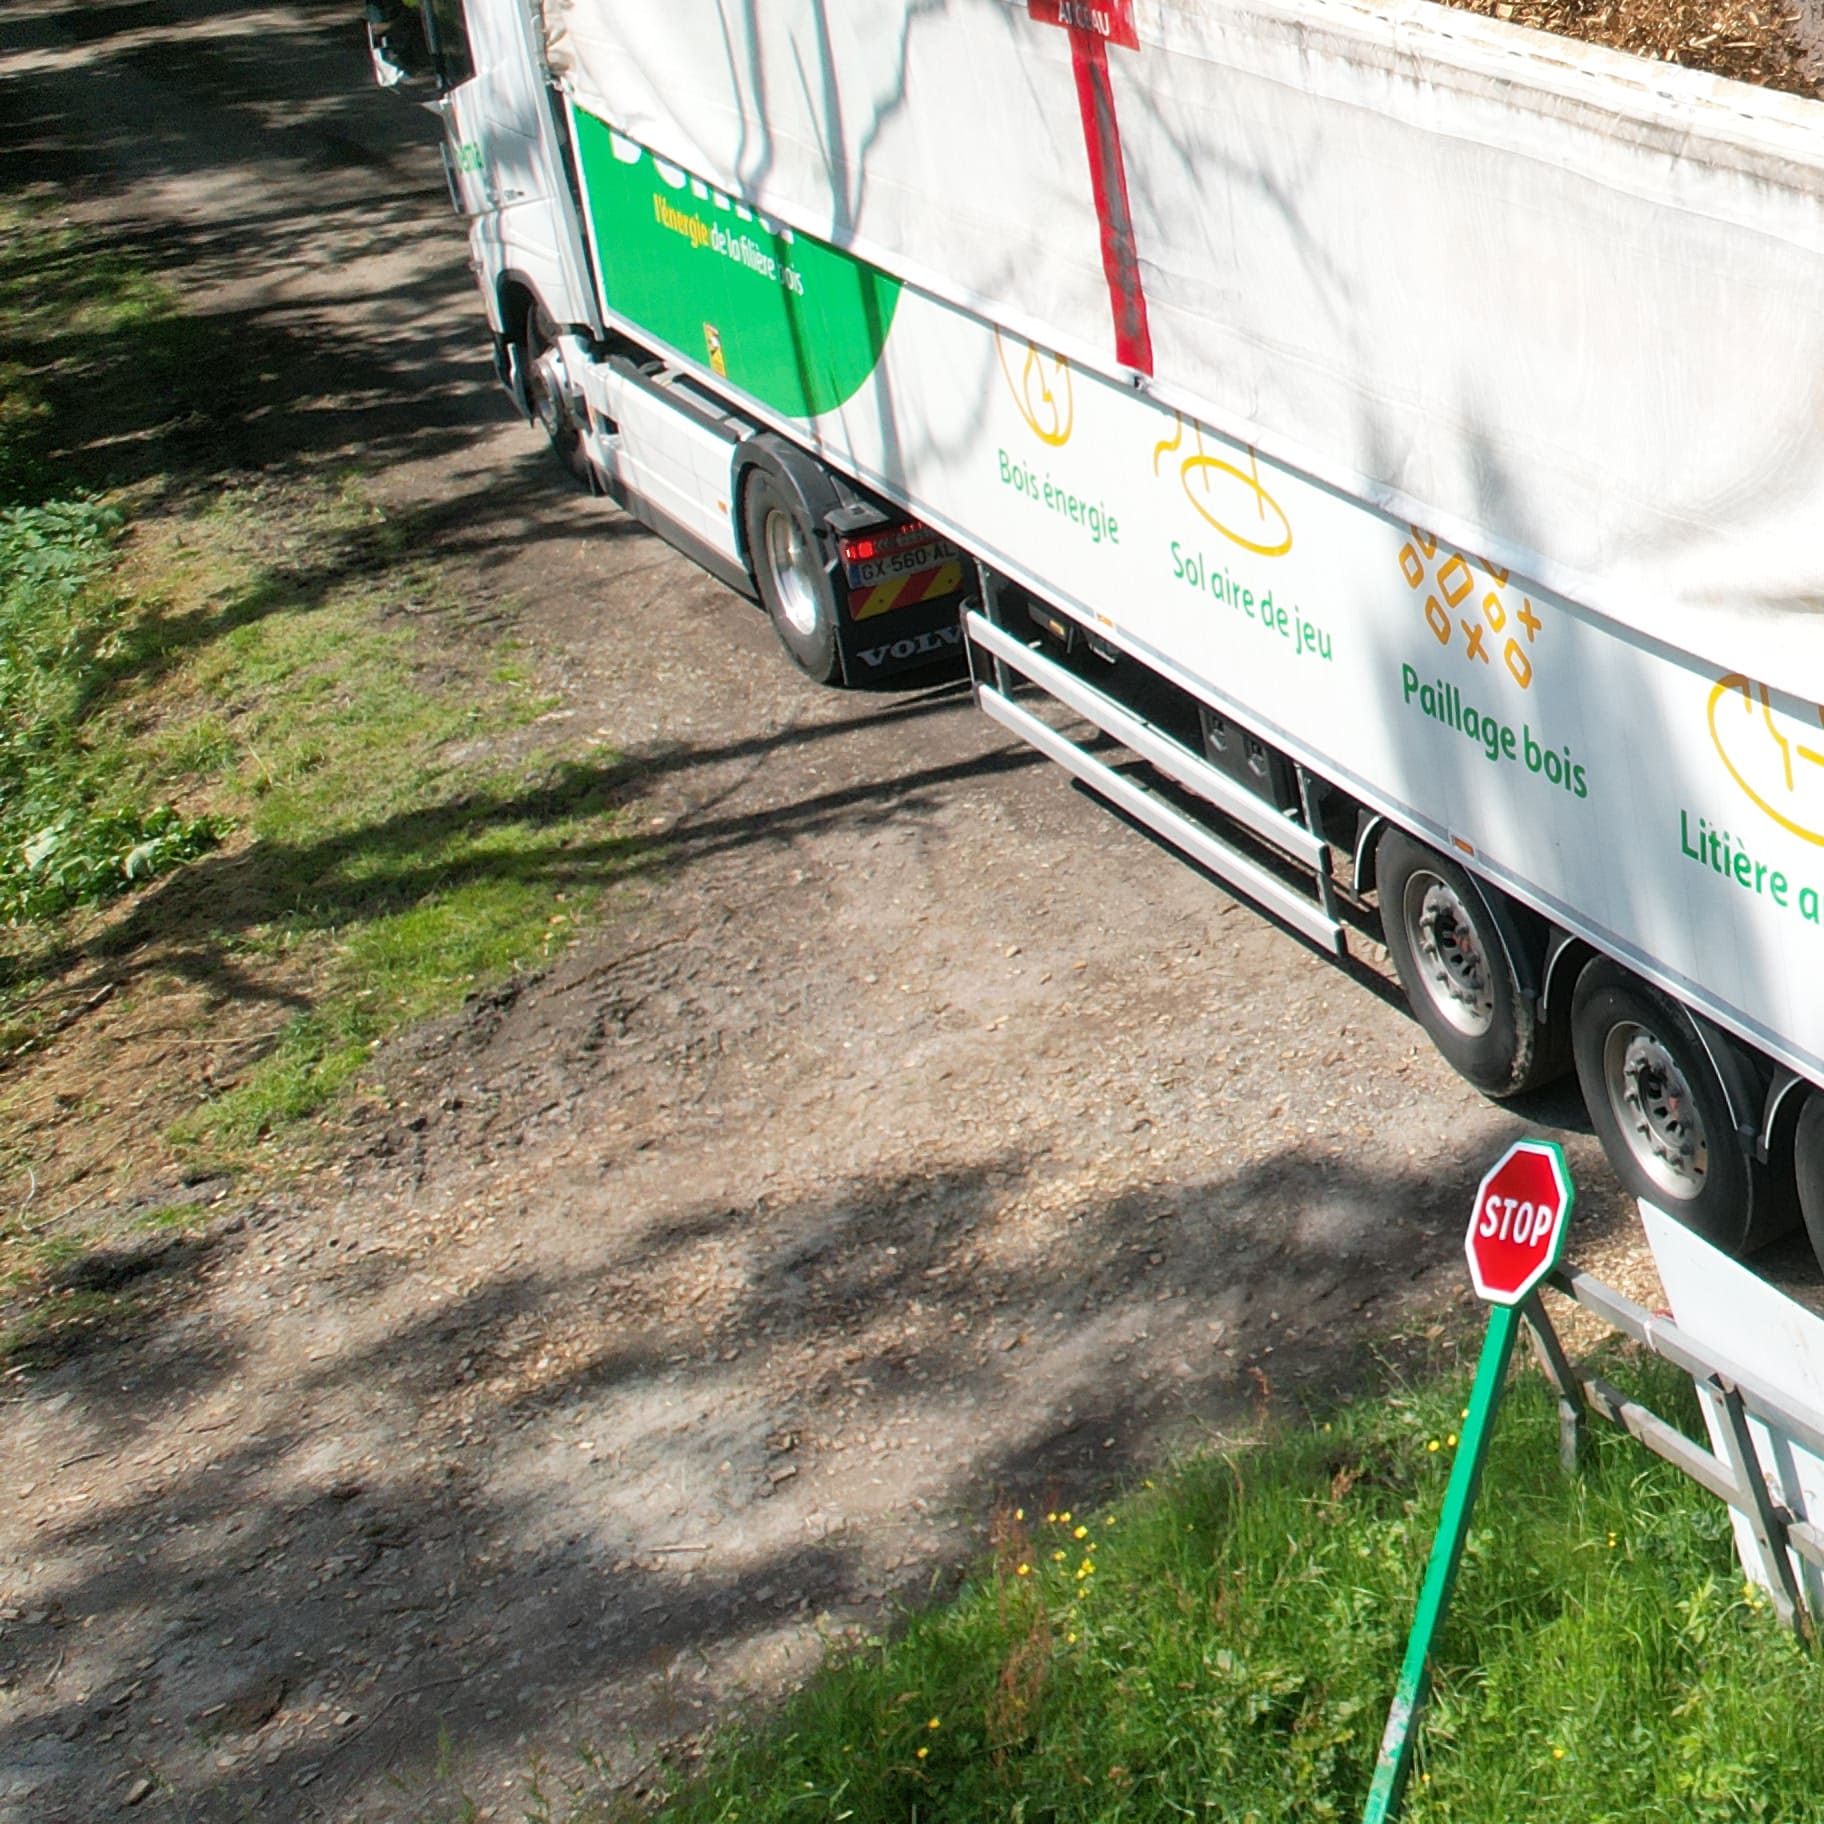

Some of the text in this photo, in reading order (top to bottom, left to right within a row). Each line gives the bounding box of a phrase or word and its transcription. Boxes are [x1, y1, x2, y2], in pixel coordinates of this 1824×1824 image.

[710, 221, 727, 255] de
[726, 228, 741, 262] la
[741, 235, 776, 280] filière
[998, 448, 1120, 544] Bois énergie
[856, 625, 962, 667] VOLV
[1171, 540, 1333, 661] Sol aire de jeu
[1402, 662, 1588, 798] Paillage bois
[1680, 808, 1789, 908] Litière
[1479, 1194, 1553, 1248] STOP
